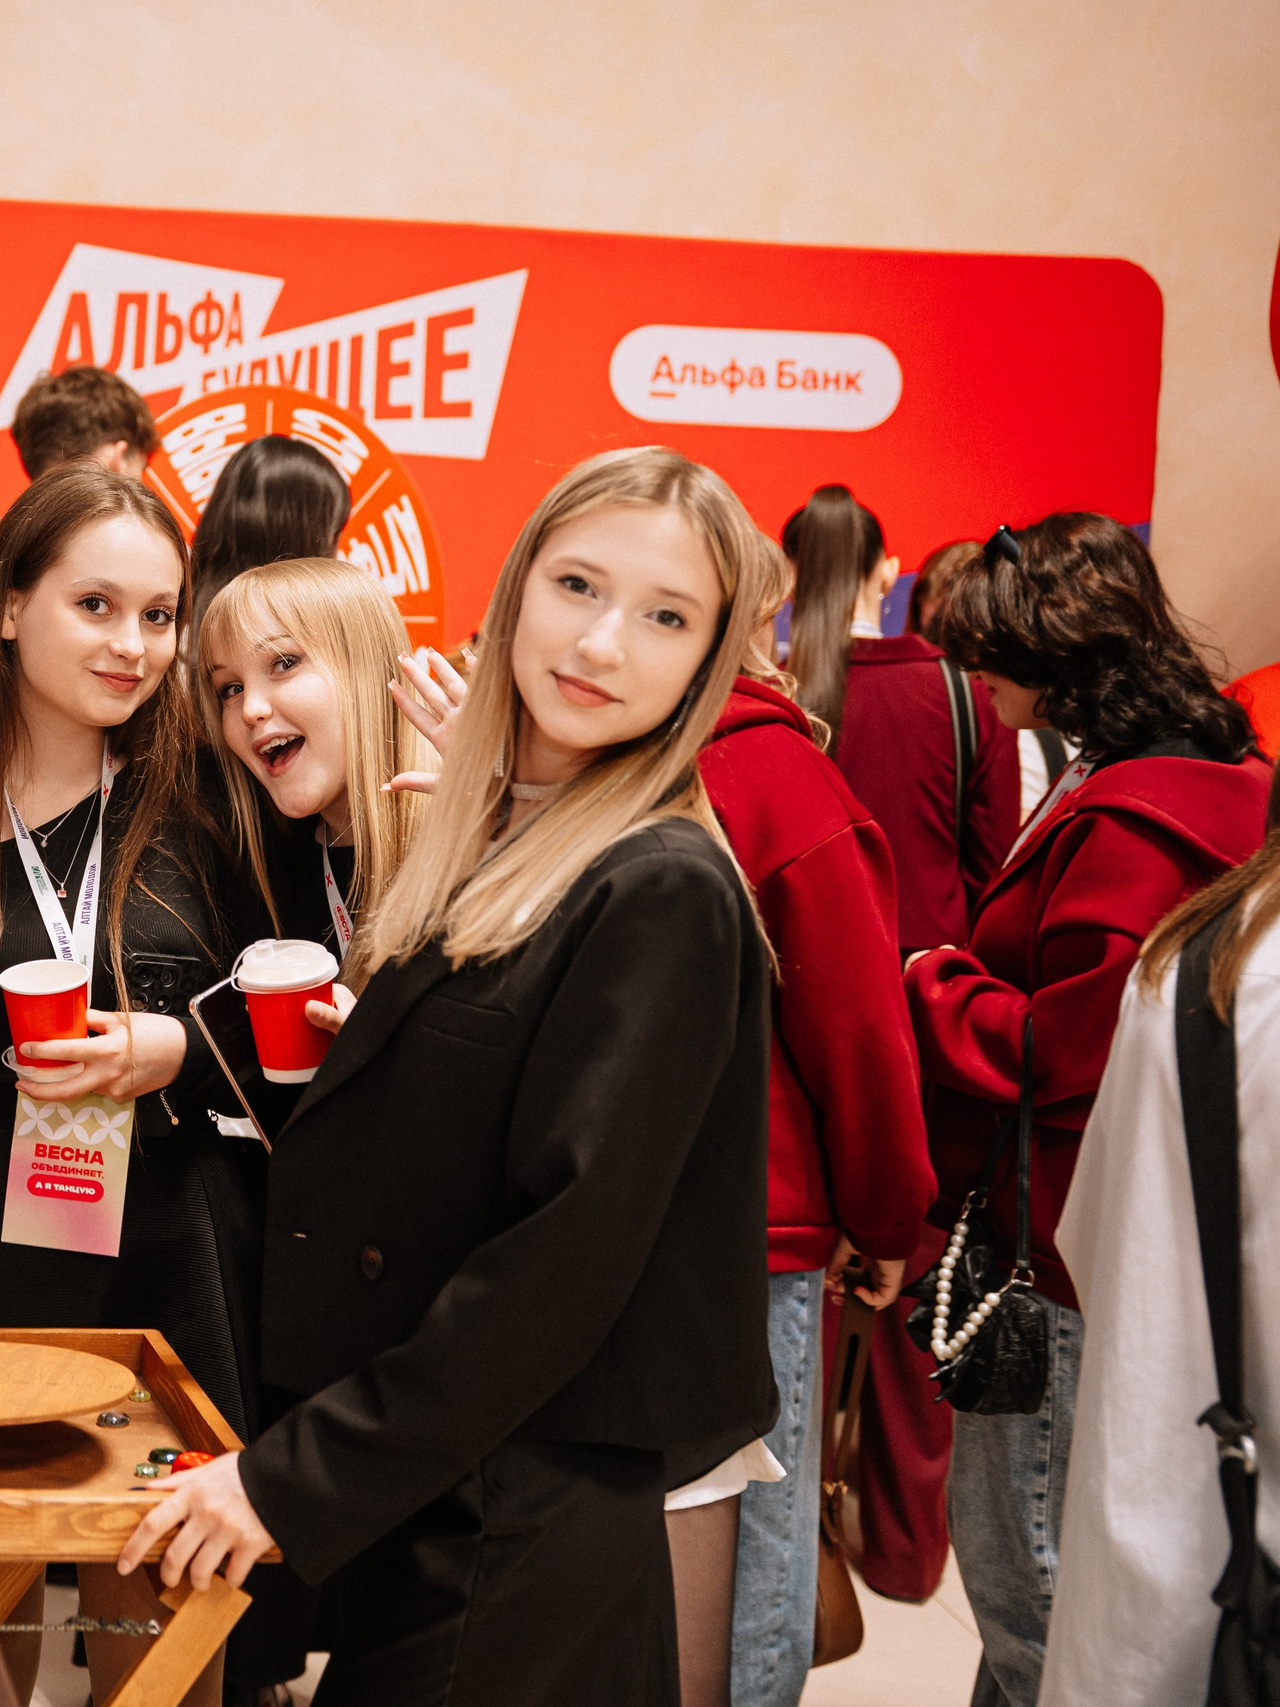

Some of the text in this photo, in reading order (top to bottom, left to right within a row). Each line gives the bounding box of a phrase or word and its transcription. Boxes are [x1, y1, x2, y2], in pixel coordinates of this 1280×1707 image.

[49, 290, 245, 376] АЛЬФА
[649, 354, 862, 397] Альфа Банк
[80, 863, 97, 925] АЛТАЙ МОЛОДОЙ
[52, 922, 71, 948] АЛТАЙ
[34, 1143, 105, 1166] ВЕСНА
[31, 1162, 105, 1180] ОБЪЕДИНЯЕТ,
[35, 1181, 96, 1196] А Я ТАНЦУЮ
